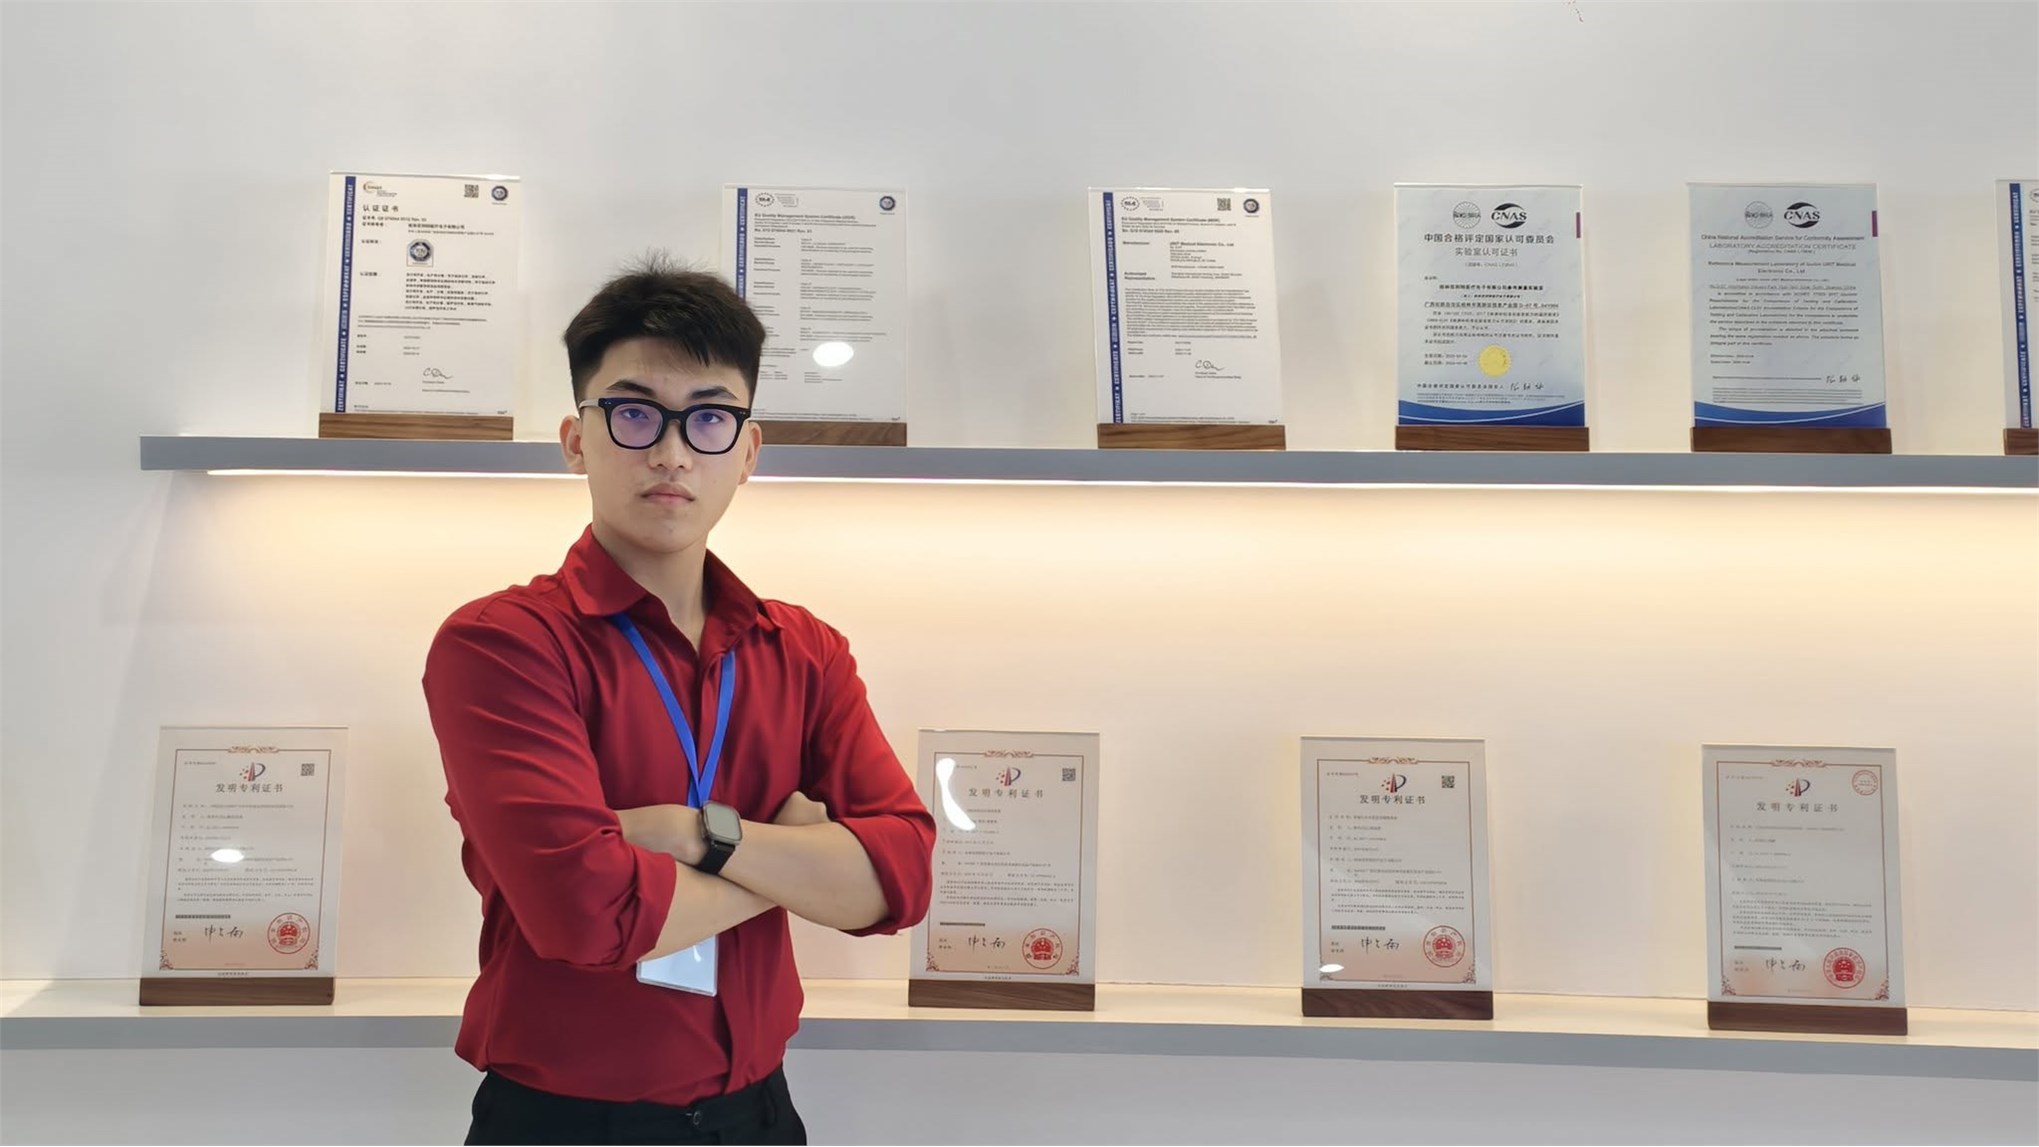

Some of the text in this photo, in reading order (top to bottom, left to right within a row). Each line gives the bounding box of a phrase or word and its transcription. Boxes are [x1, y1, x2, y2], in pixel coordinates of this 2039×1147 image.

[362, 203, 399, 212] 认证证书
[1491, 210, 1528, 222] CNAS
[1783, 210, 1820, 221] CNAS
[1424, 233, 1555, 244] 中国合格评定国家认可委员会
[1455, 247, 1518, 257] 实验室认可证书
[215, 783, 284, 793] 发明专利证书
[968, 787, 1044, 799] 发明专利证书
[1359, 794, 1426, 805] 发明专利证书
[1756, 801, 1839, 813] 发明专利证书
